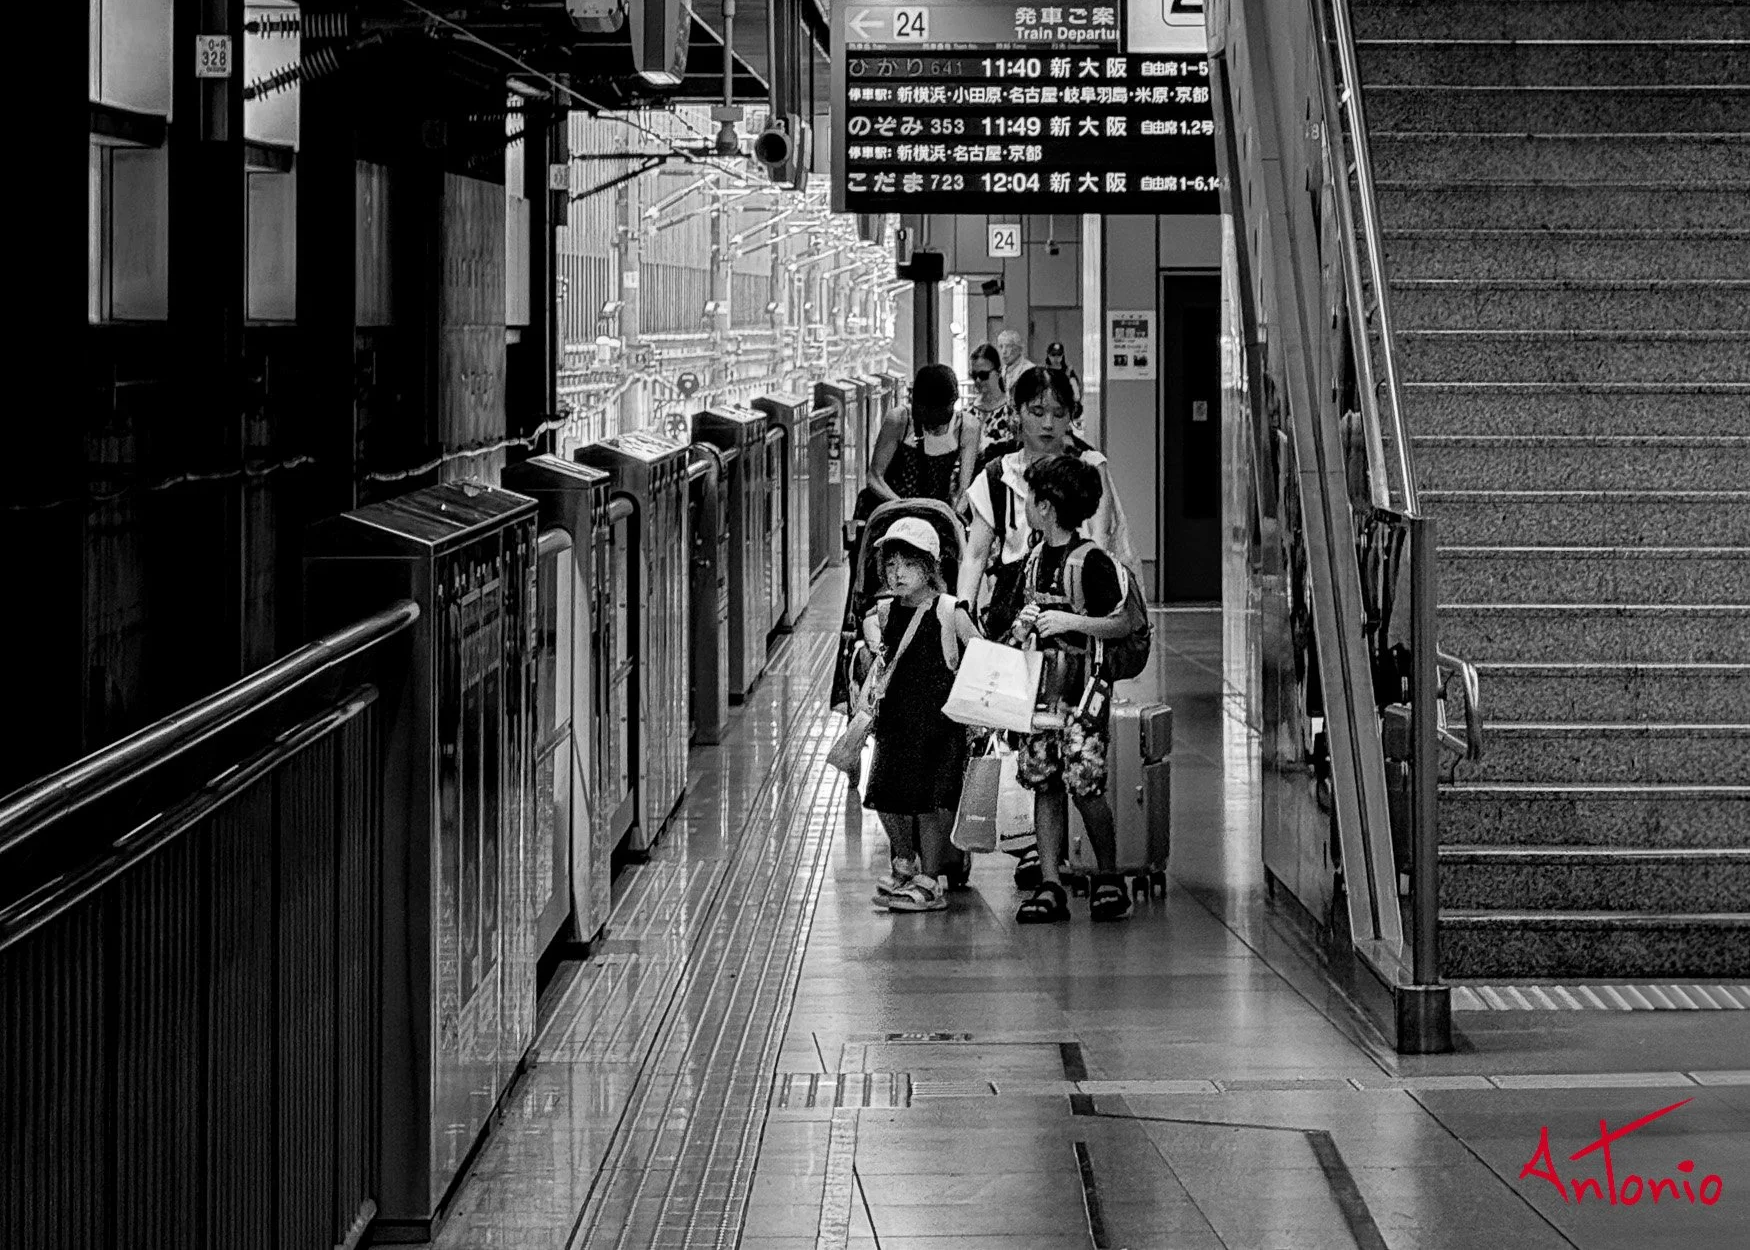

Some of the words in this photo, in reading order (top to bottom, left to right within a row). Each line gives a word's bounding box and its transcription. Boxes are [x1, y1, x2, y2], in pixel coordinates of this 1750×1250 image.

[896, 11, 926, 37] 24
[1014, 27, 1053, 40] Train
[202, 51, 226, 66] 328
[981, 58, 1041, 78] 11:40
[931, 119, 965, 135] 353
[981, 116, 1041, 137] 11:49
[931, 174, 965, 191] 723
[981, 171, 1041, 194] 12:04
[994, 231, 1015, 250] 24
